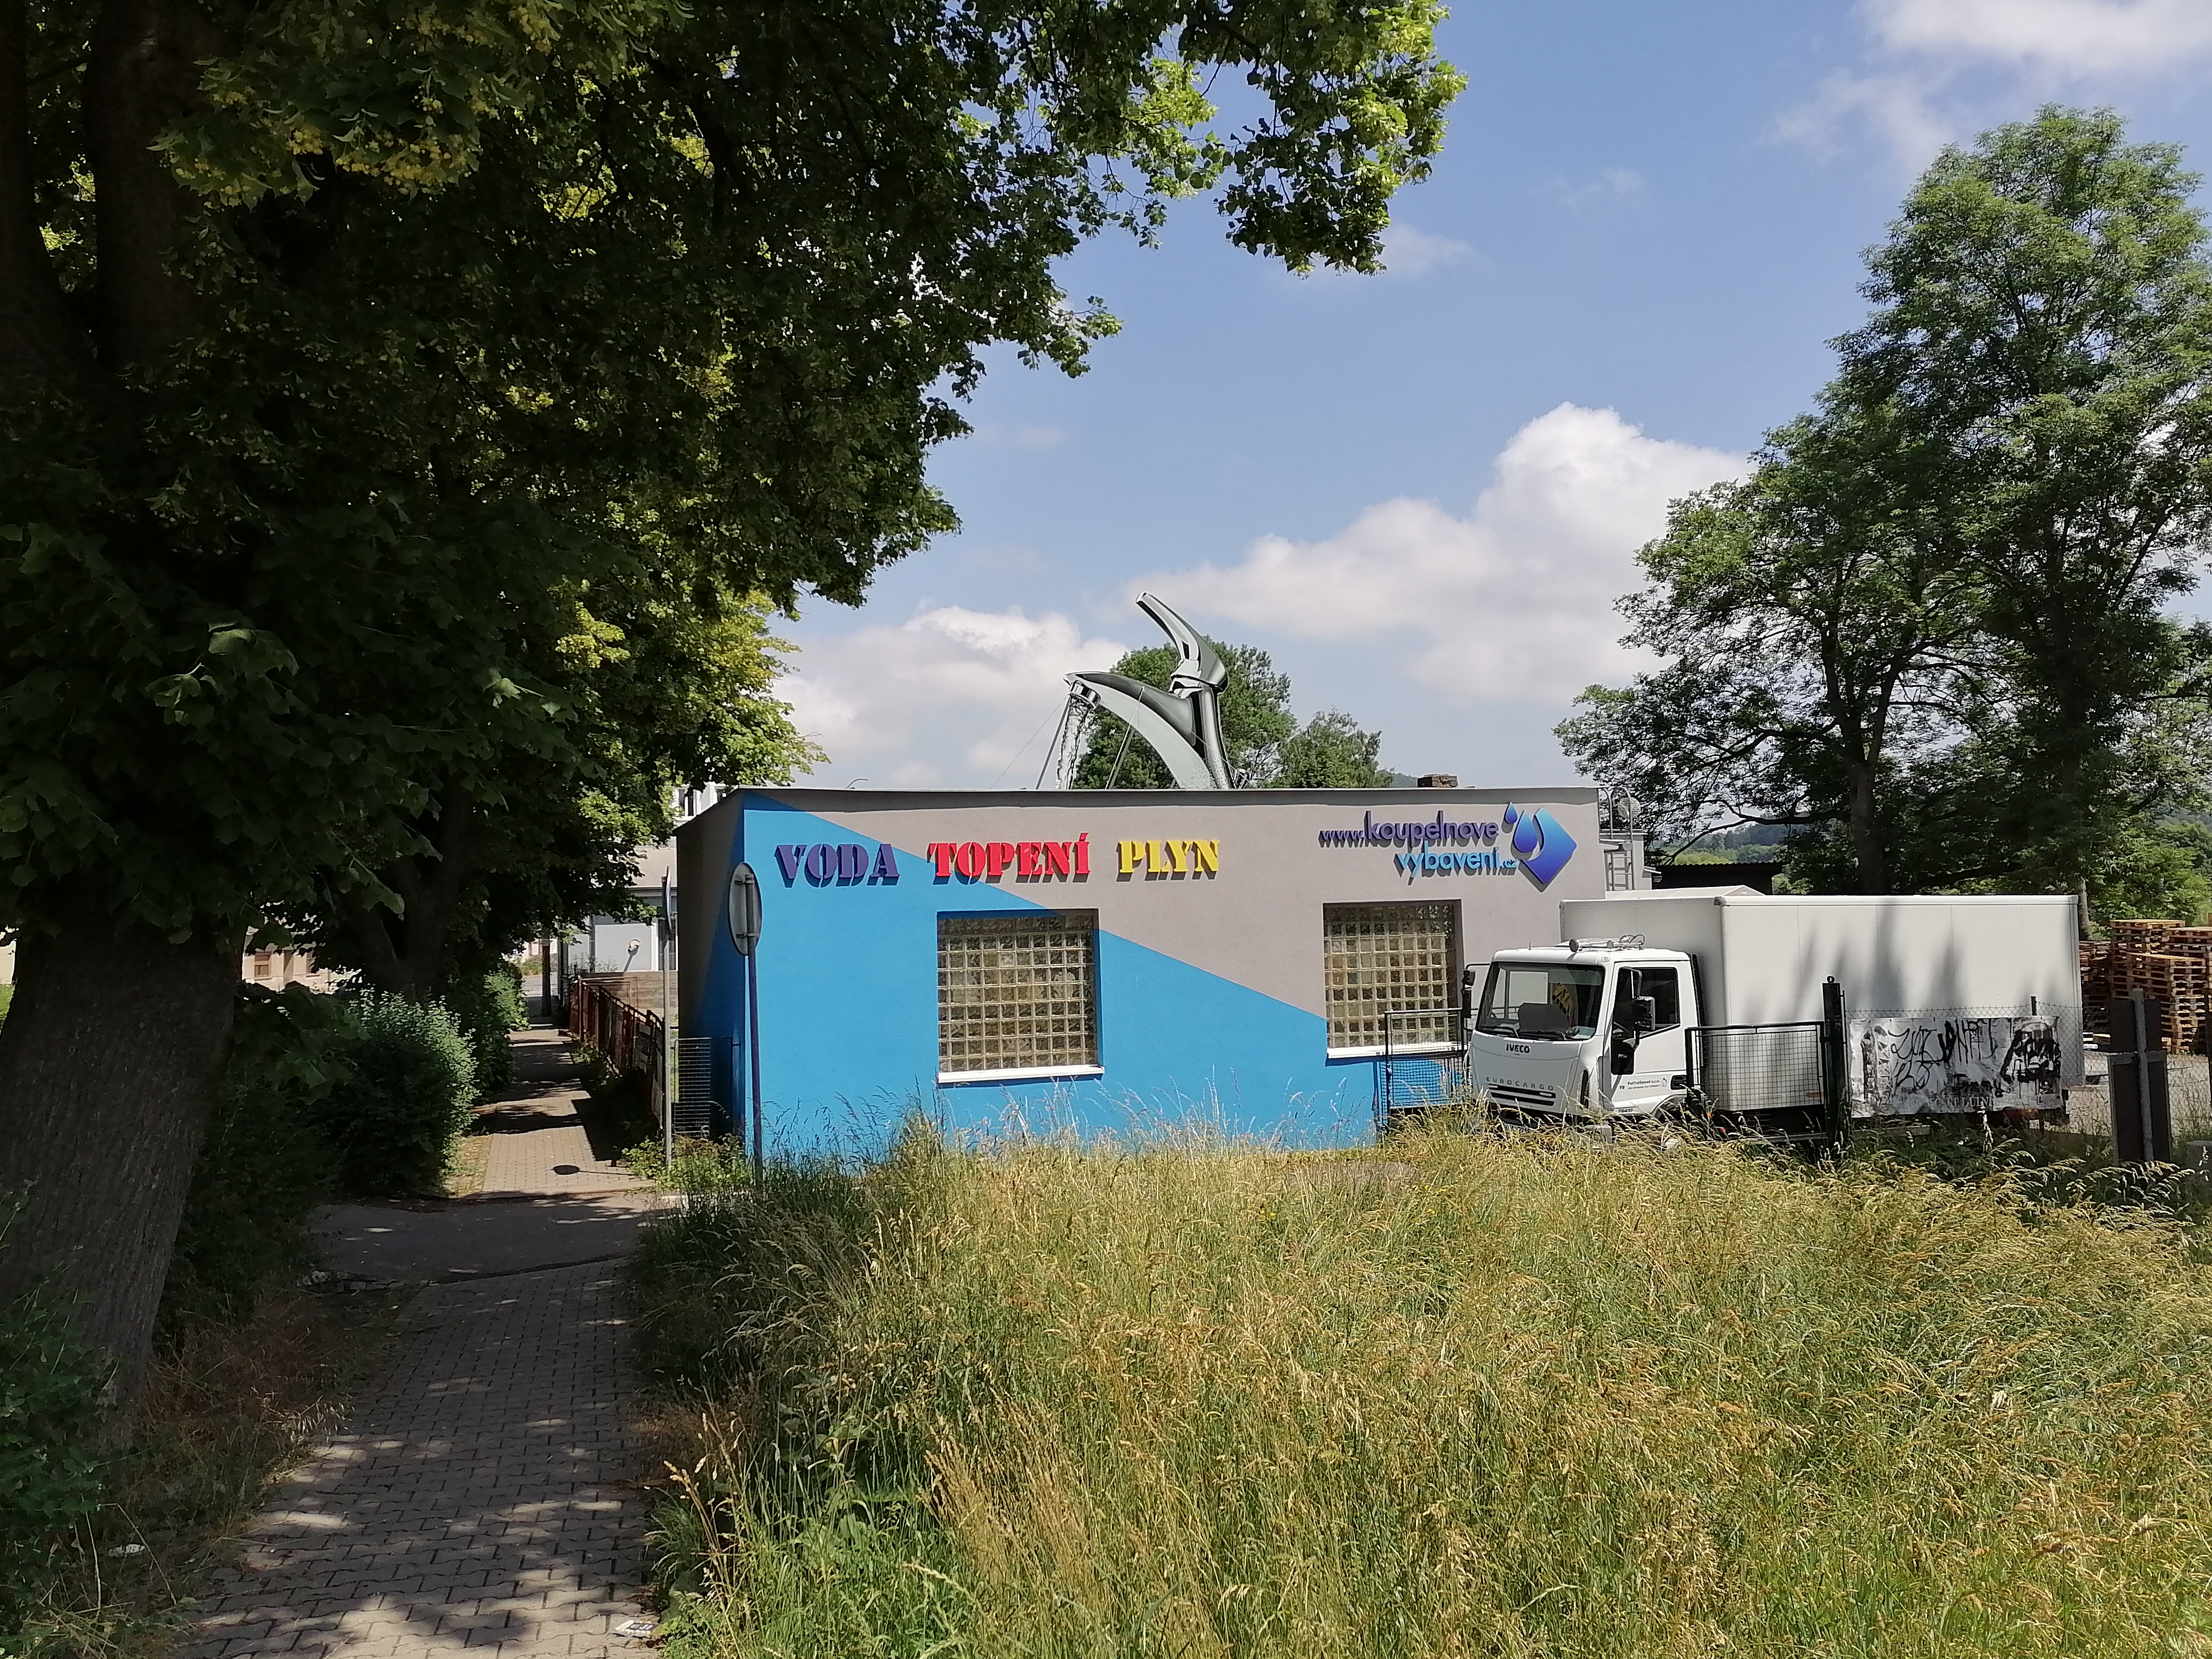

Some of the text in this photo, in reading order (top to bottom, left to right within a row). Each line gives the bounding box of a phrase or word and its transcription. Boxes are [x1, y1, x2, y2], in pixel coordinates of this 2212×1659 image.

[1319, 810, 1499, 847] www.koupelnove
[775, 832, 1220, 883] VODA TOPENÍ PLYN
[1395, 841, 1517, 878] vybaveni.cz
[1506, 1043, 1531, 1053] IVECO
[1485, 1076, 1554, 1091] EUROCARGO
